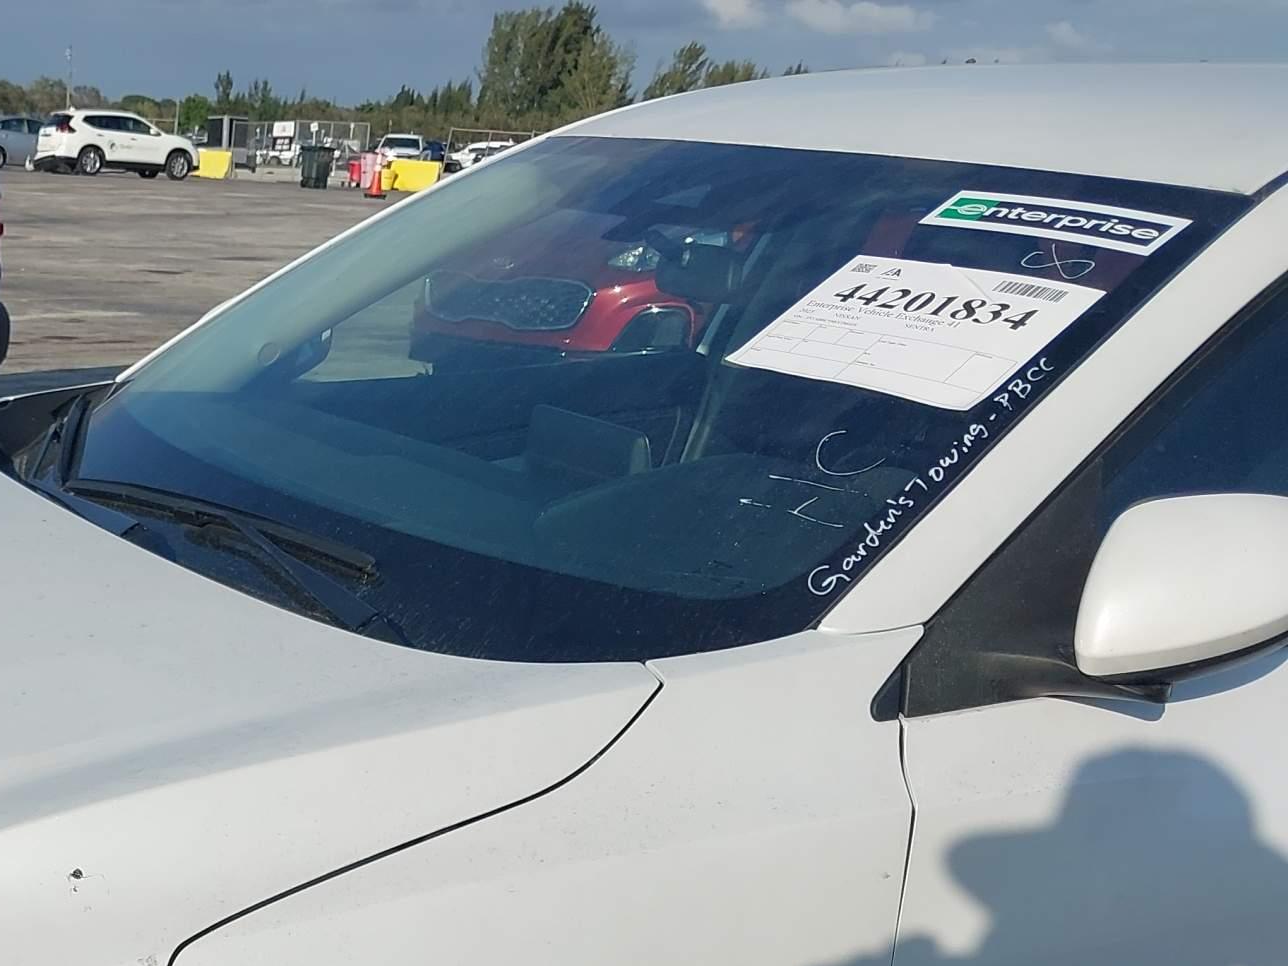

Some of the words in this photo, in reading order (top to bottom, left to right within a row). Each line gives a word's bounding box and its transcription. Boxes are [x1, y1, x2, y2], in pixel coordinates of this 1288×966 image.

[950, 203, 1161, 240] enterprise
[806, 299, 856, 314] Enterprise
[858, 305, 895, 319] Vehicle
[894, 313, 945, 327] Exchange
[833, 283, 1040, 331] 44201834
